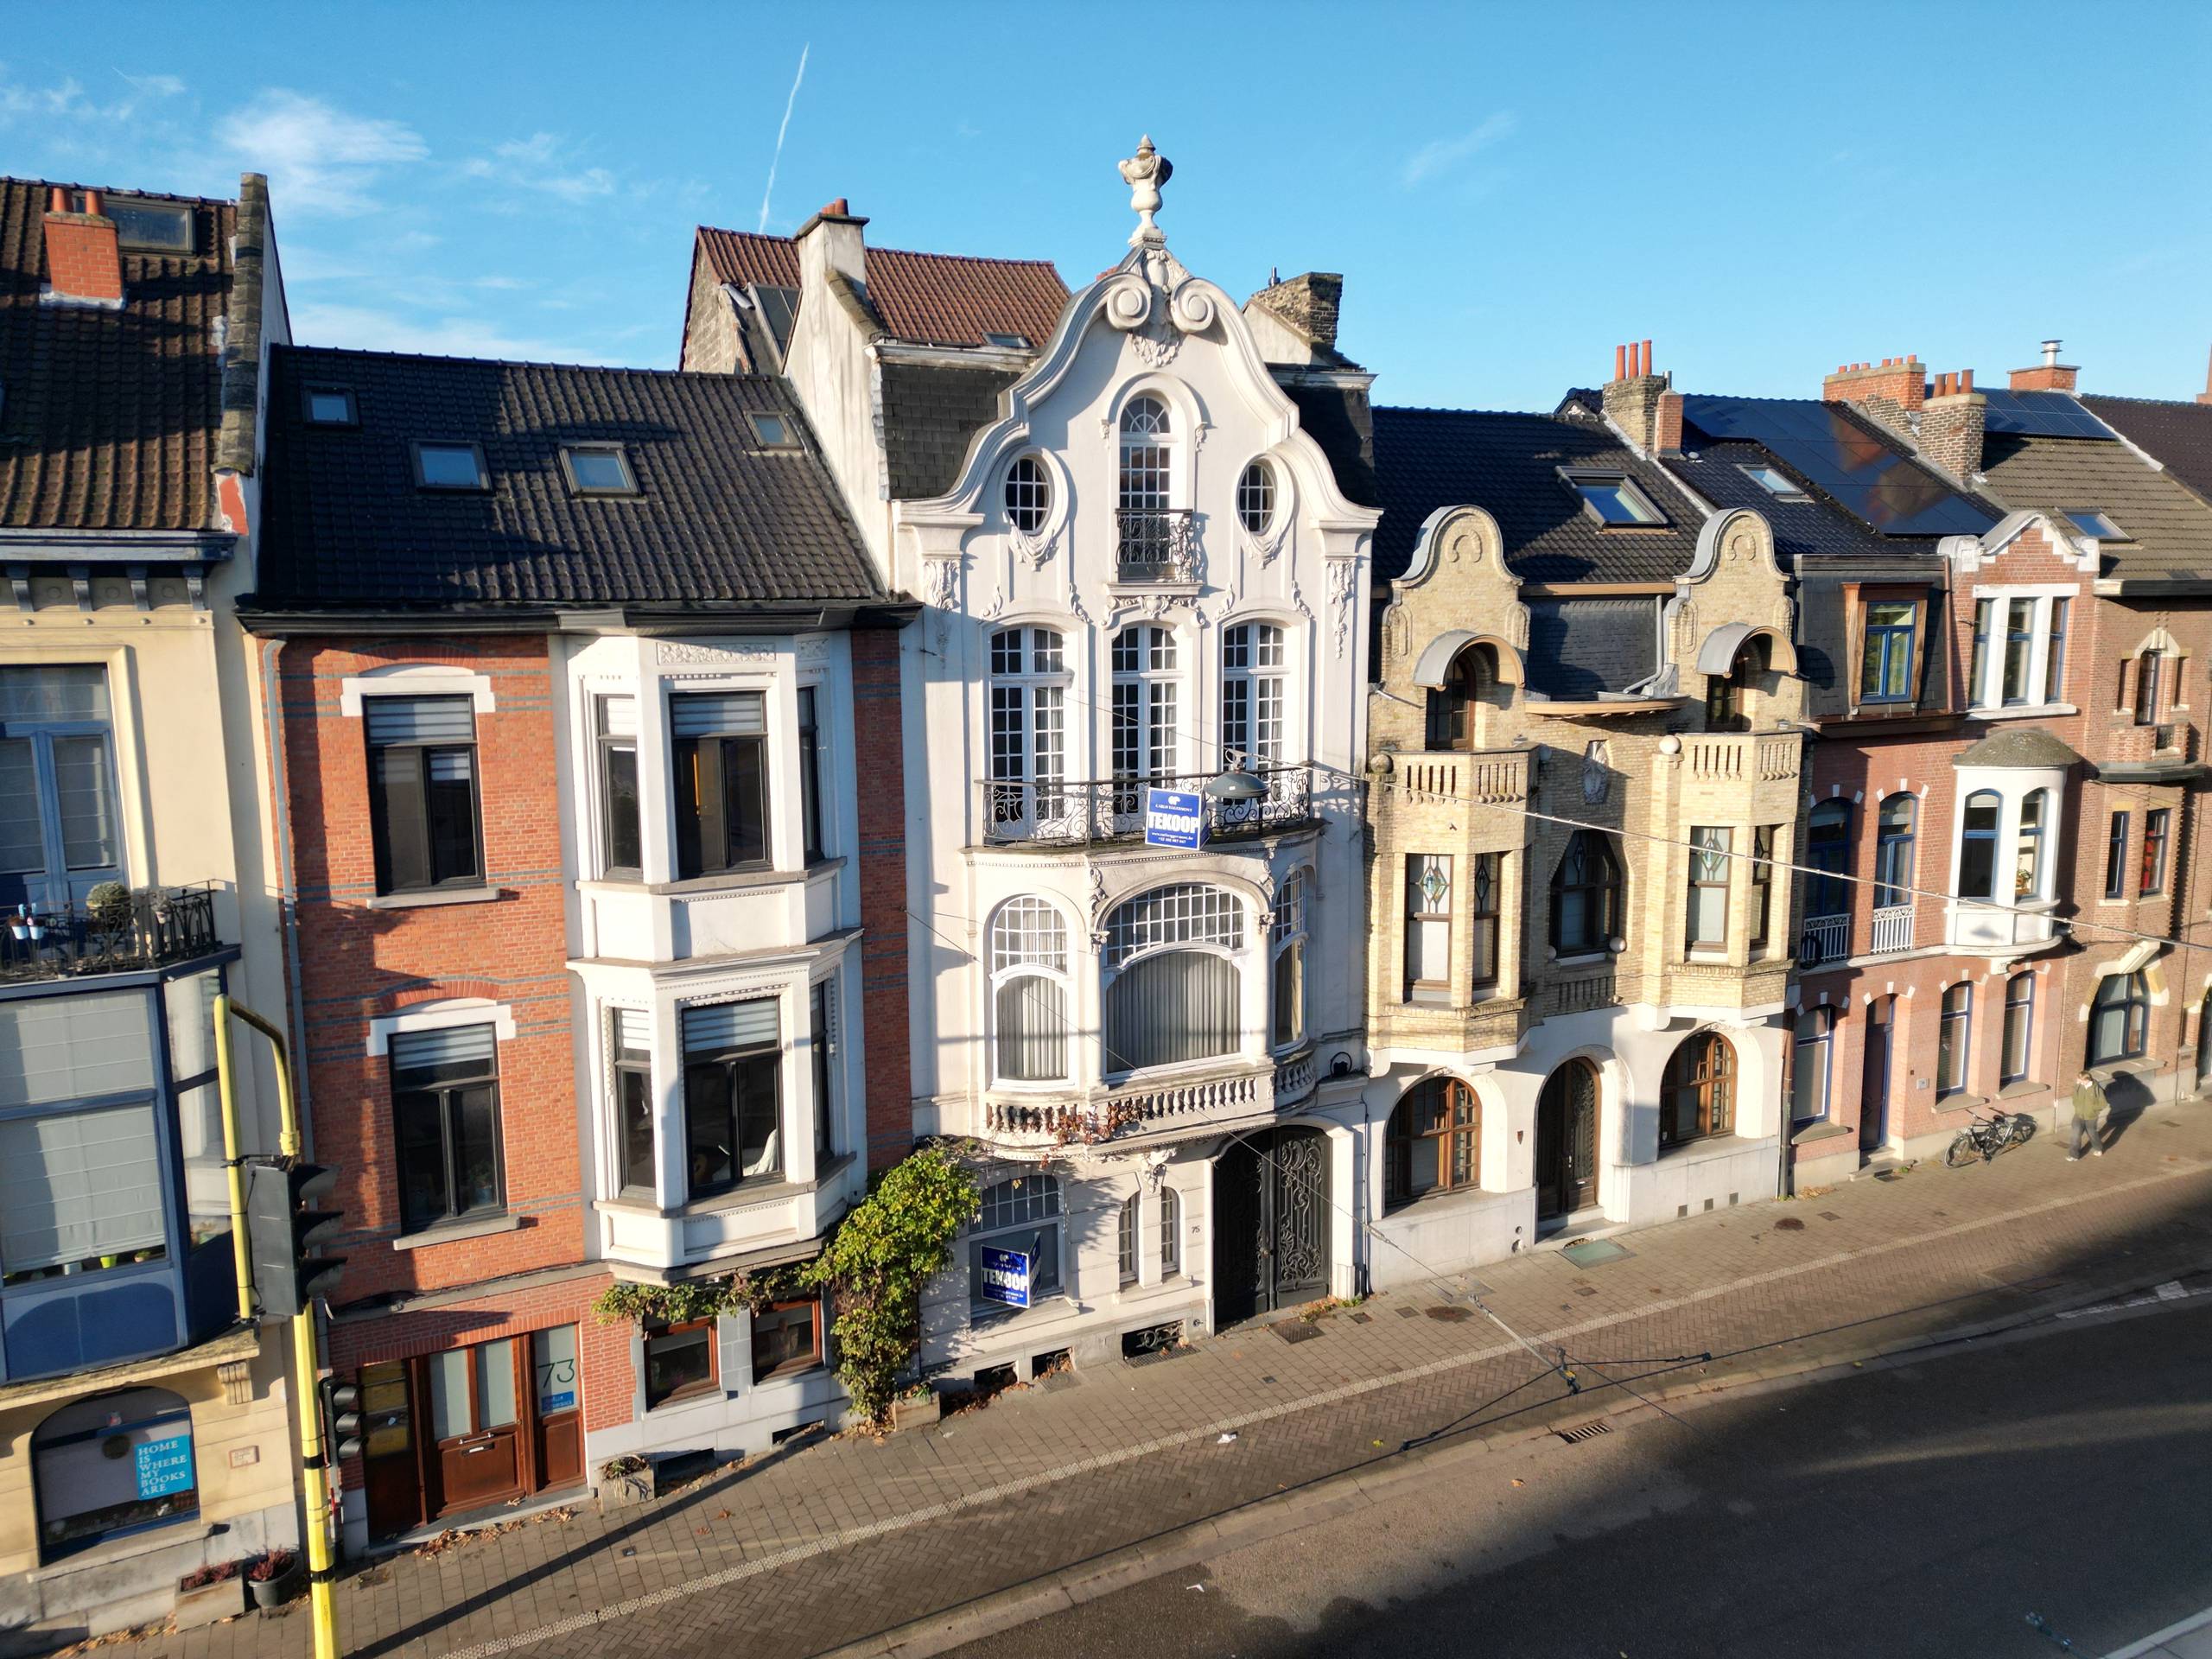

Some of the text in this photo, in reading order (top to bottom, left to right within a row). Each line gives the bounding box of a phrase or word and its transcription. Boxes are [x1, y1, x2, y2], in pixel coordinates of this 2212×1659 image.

[1192, 1225, 1200, 1234] 75
[537, 1358, 575, 1389] 73
[138, 1440, 179, 1456] HOME
[138, 1454, 150, 1465] IS
[138, 1454, 188, 1471] WHERE
[140, 1468, 159, 1480] MY
[141, 1471, 186, 1488] BOOKS
[141, 1483, 167, 1497] ARE
